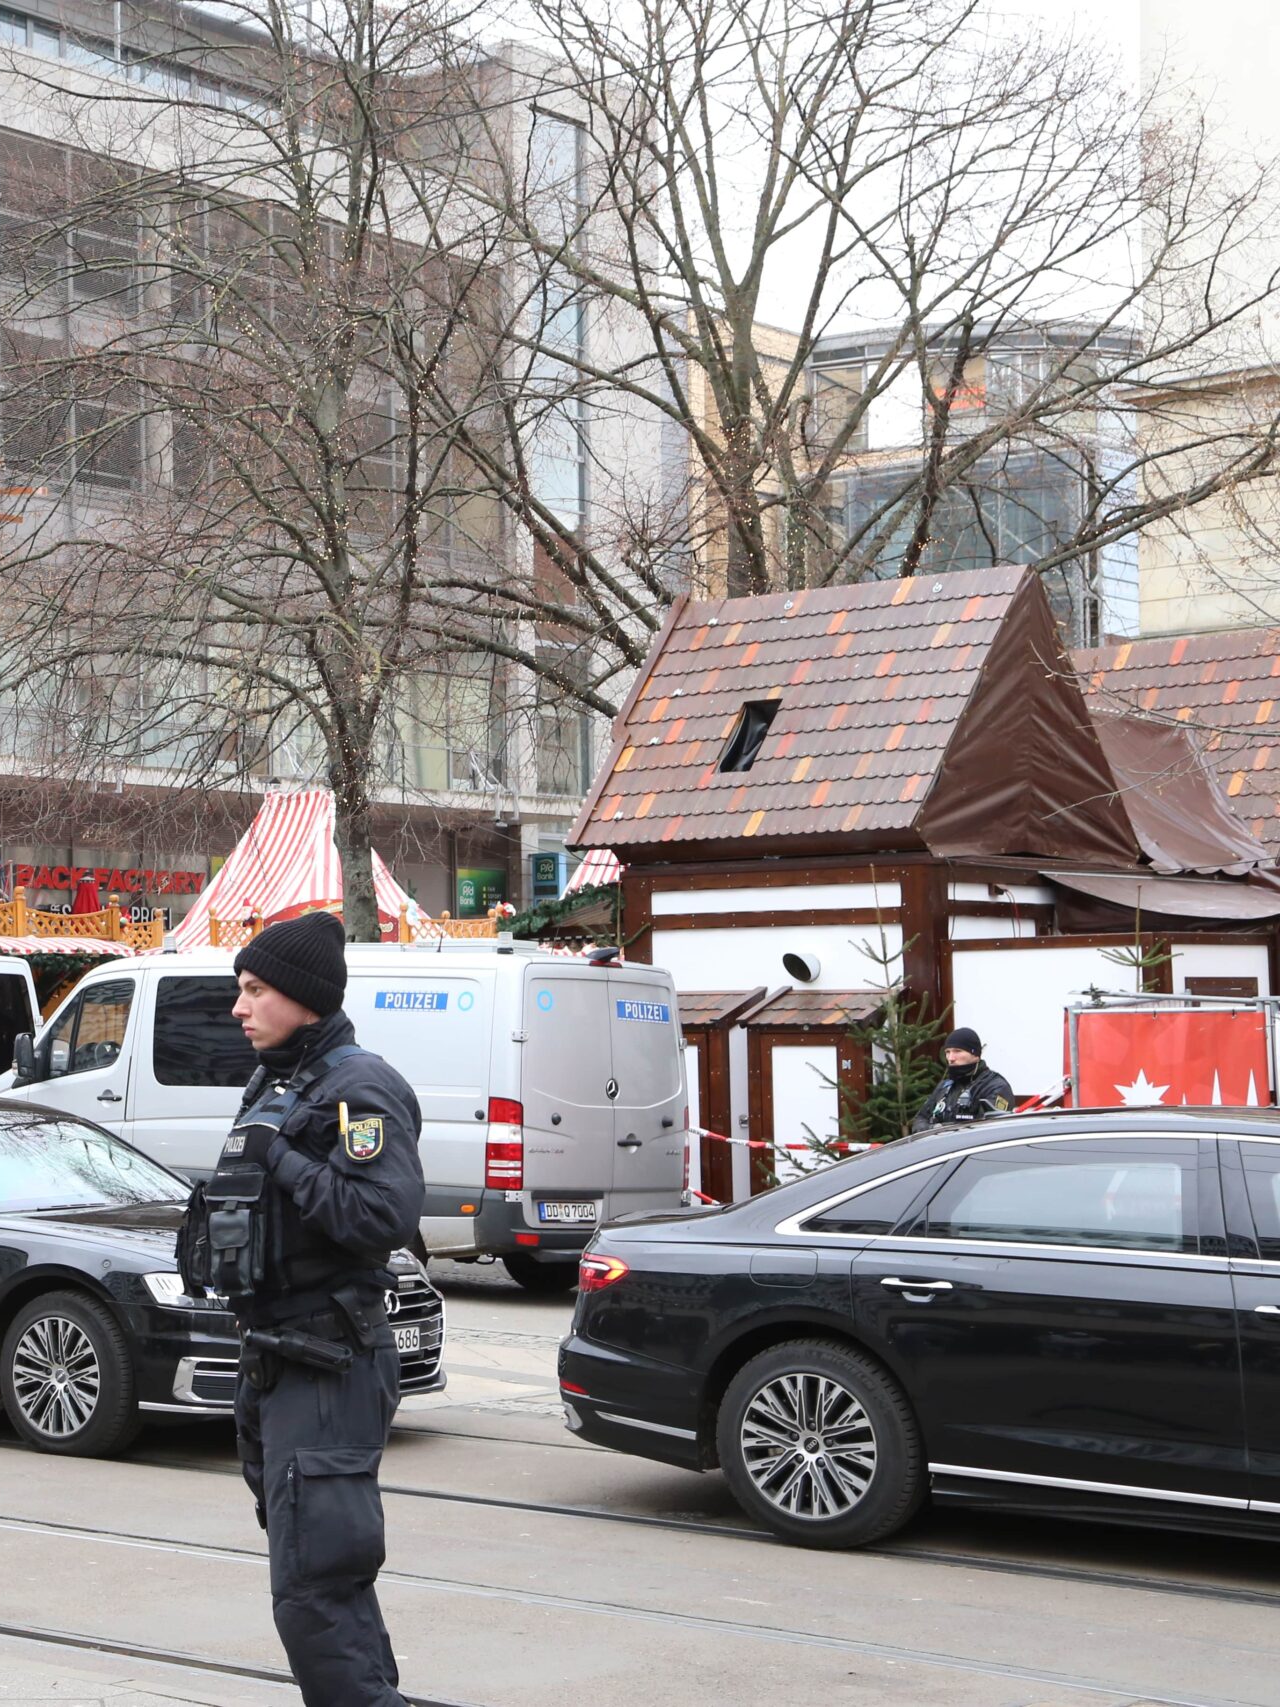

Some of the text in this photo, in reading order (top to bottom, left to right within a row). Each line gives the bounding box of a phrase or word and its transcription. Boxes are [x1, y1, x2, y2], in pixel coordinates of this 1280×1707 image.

[384, 993, 438, 1009] POLIZEI
[624, 1002, 663, 1020] POLIZEI
[349, 1120, 379, 1132] POLIZEI
[225, 1136, 246, 1153] POLIZEI
[546, 1204, 595, 1219] DD Q 7004
[397, 1329, 419, 1349] 686
